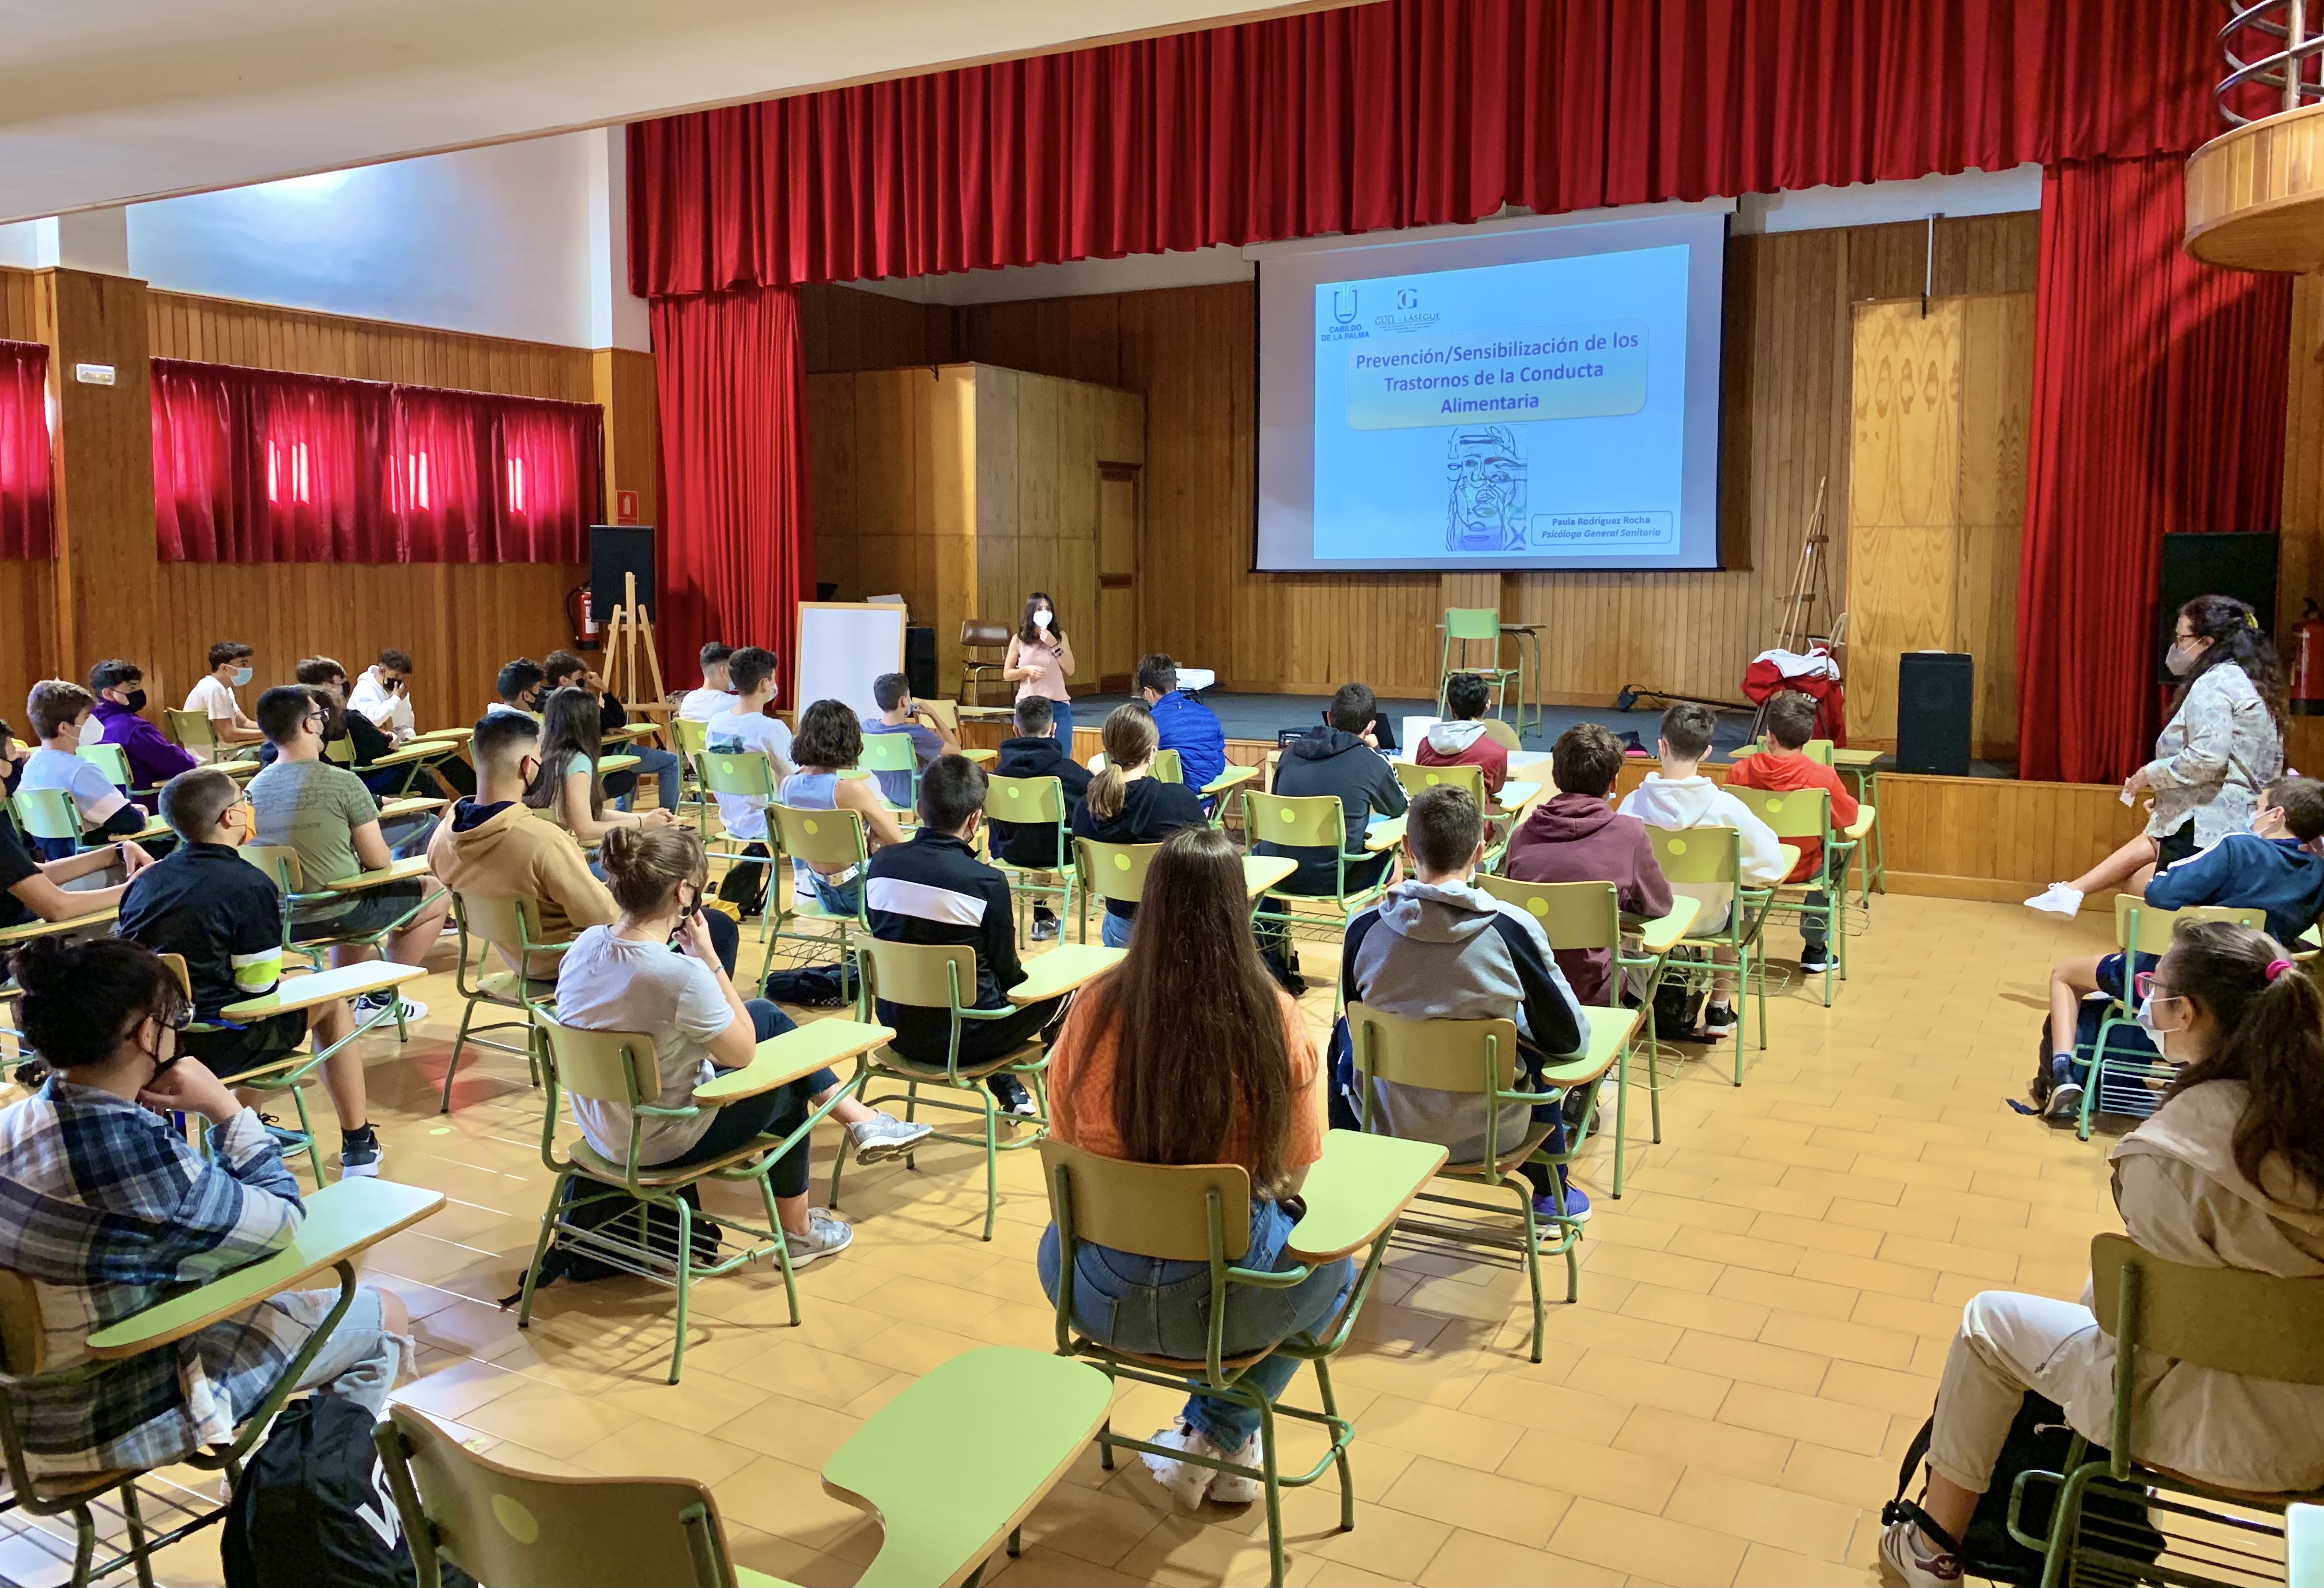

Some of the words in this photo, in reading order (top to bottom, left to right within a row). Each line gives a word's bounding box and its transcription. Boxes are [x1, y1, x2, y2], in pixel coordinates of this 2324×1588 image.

[1329, 324, 1362, 333] CABILDO
[1344, 331, 1369, 340] PALMA
[1356, 337, 1579, 368] Prevención/Sensibilización
[1585, 334, 1607, 351] de
[1613, 331, 1639, 348] los
[1384, 375, 1469, 392] Trastornos
[1474, 369, 1495, 386] de
[1500, 368, 1515, 384] la
[1520, 363, 1604, 382] Conducta
[1440, 393, 1539, 414] Alimentaria
[1623, 516, 1650, 525] Rocha
[1541, 530, 1582, 540] Psicóloga
[1584, 529, 1618, 538] General
[1620, 528, 1661, 537] Sanitaria
